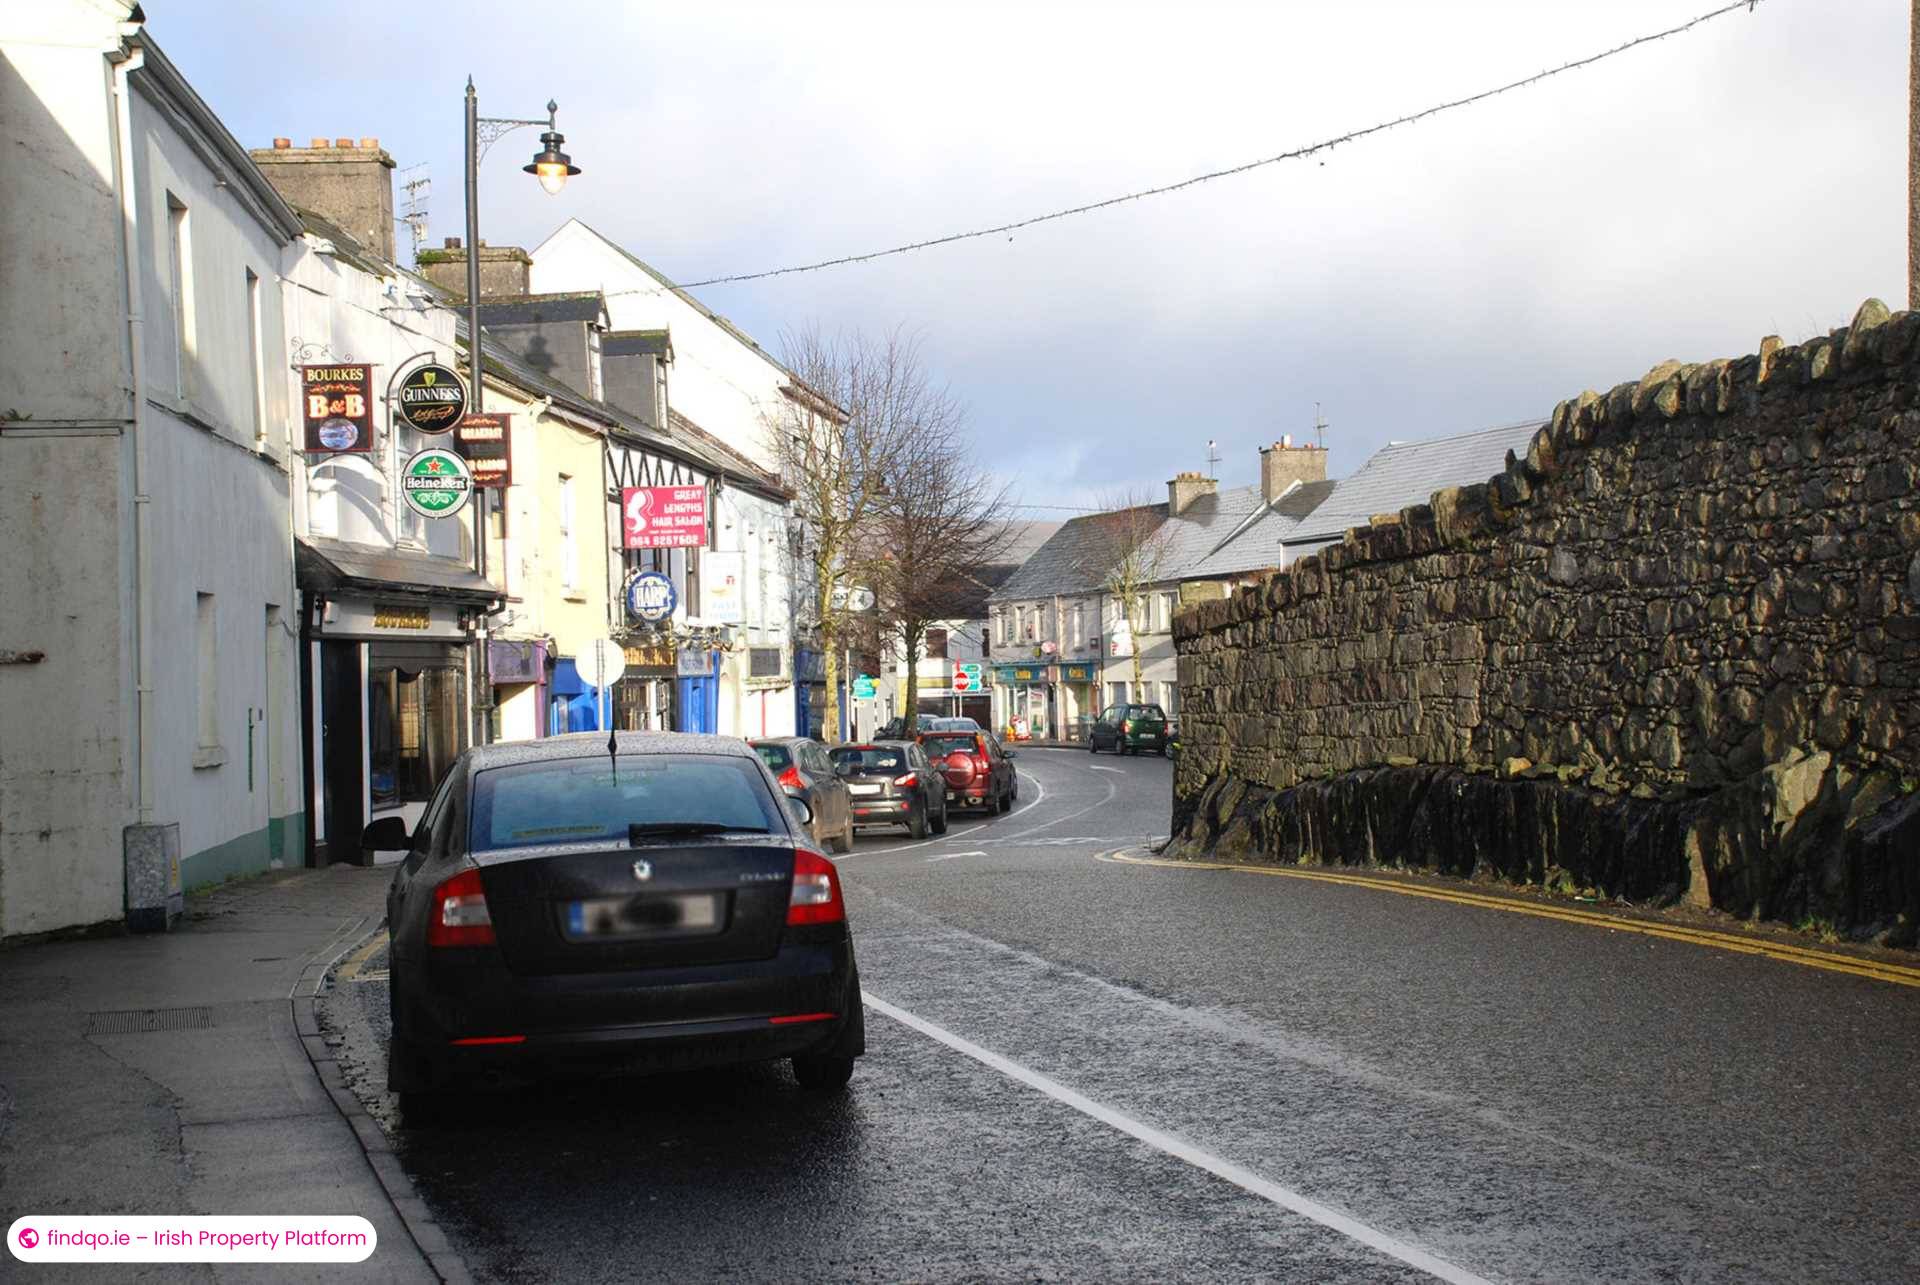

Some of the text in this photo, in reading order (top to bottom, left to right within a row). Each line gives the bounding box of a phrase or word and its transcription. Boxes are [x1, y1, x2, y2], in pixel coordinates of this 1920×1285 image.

[306, 368, 364, 381] BOURKES
[402, 387, 462, 402] GUINNESS
[308, 394, 366, 418] B&B
[407, 477, 465, 489] Heineken
[674, 489, 702, 500] GREAT
[663, 502, 703, 514] LENGTHS
[652, 515, 703, 528] HAIR SALON
